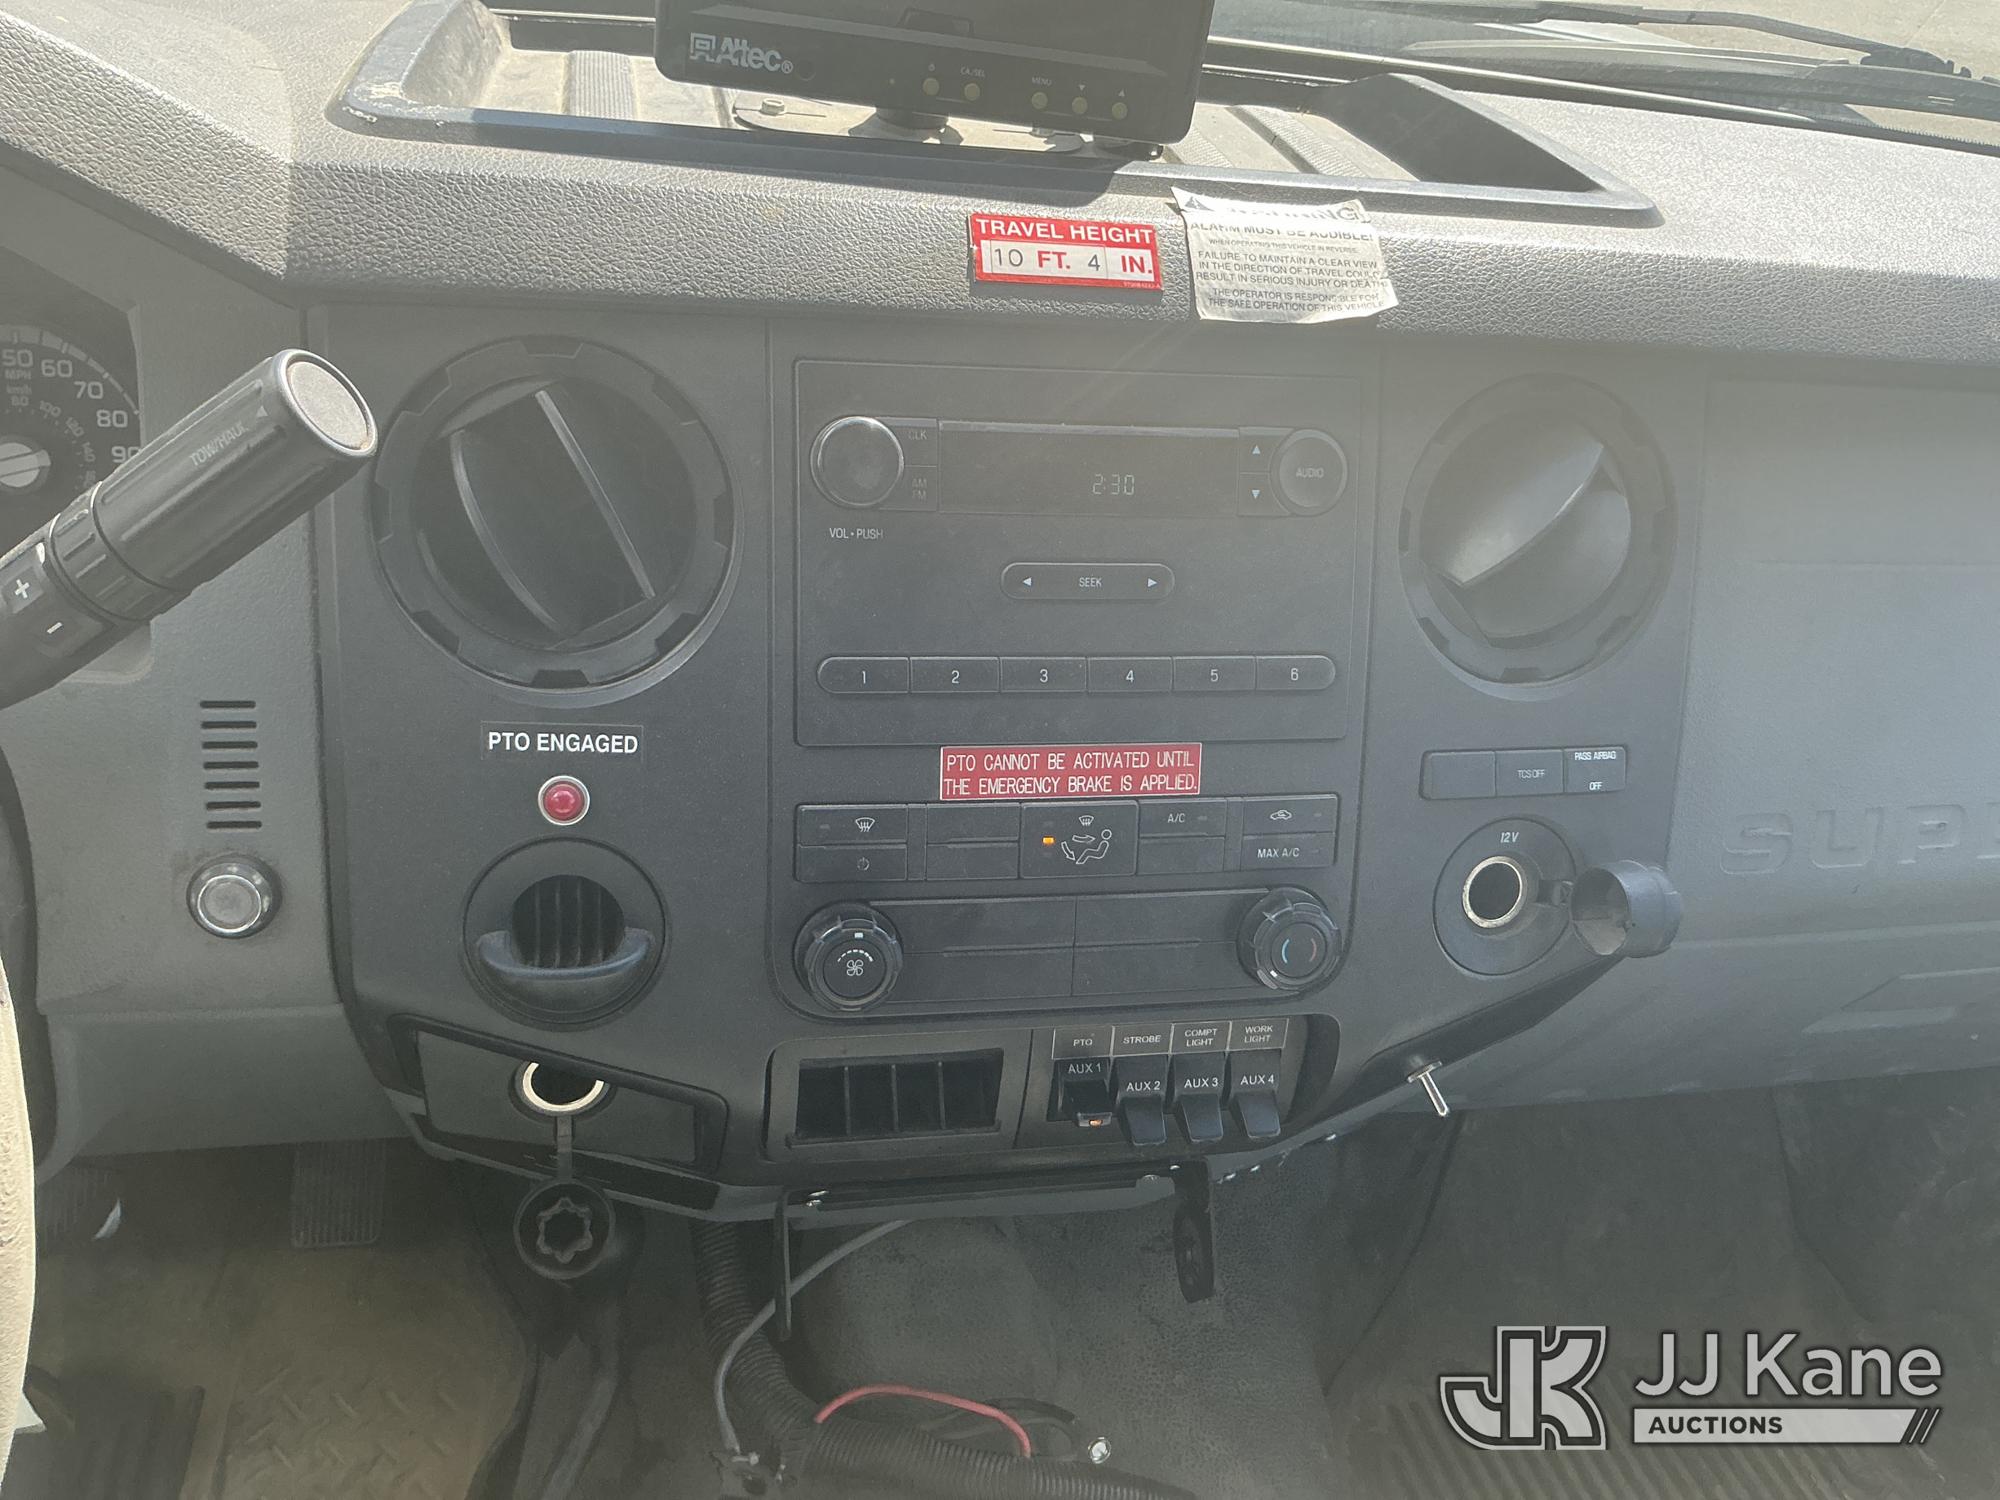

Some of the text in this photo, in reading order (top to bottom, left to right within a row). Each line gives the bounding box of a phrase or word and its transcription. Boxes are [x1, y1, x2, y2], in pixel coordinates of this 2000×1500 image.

[975, 218, 1153, 244] TRAVEL HEIGHT
[994, 248, 1153, 274] 10 FT. 4 IN.
[1198, 251, 1377, 269] FAILURE TO MAINTAIN A CLEAR VIEW
[1199, 261, 1209, 270] IN
[1211, 262, 1231, 271] THE
[1234, 263, 1287, 274] DIRECTION
[1289, 266, 1303, 275] OF
[1304, 267, 1343, 278] TRAVEL
[1196, 272, 1235, 282] RESULT
[1237, 273, 1247, 282] IN
[1250, 274, 1294, 285] SERIOUS
[1297, 277, 1331, 288] INJURY
[1333, 279, 1348, 288] OR
[1212, 287, 1231, 296] THE
[1232, 289, 1282, 299] OPERATOR
[1284, 292, 1293, 300] IS
[1208, 298, 1226, 306] THE
[1228, 299, 1251, 309] SAFE
[1253, 300, 1305, 311] OPERATION
[1307, 303, 1320, 312] OF
[5, 370, 32, 380] MPH
[2, 349, 34, 367] 50
[41, 359, 73, 378] 60
[74, 381, 104, 400] 70
[96, 409, 128, 428] 80
[908, 429, 928, 441] CLK
[1296, 466, 1325, 479] AUDIO
[1092, 473, 1136, 496] 2:30
[829, 527, 884, 540] VOL PUSH
[1078, 576, 1103, 588] SEEK
[861, 667, 1299, 685] 1 2 3 4 5 6
[487, 731, 639, 754] PTO ENGAGED
[946, 750, 1195, 772] PTO CANNOT BE ACTIVATED UNTIL
[1574, 750, 1617, 761] PASS AIRBAG
[1517, 768, 1546, 779] TCS OFF
[943, 773, 1198, 795] THE EMERGENCY BRAKE IS APPLIED.
[1589, 781, 1603, 791] OFF
[1167, 812, 1186, 824] A/C
[1256, 846, 1301, 860] MAX A/C
[1184, 1028, 1219, 1038] COMPT
[1244, 1024, 1274, 1034] WORK
[1073, 1037, 1093, 1047] PTO
[1122, 1034, 1161, 1045] STROBE
[1186, 1037, 1214, 1047] LIGHT
[1244, 1034, 1272, 1044] LIGHT
[1067, 1063, 1102, 1074] AUX 1
[1126, 1080, 1161, 1092] AUX 2
[1184, 1077, 1219, 1089] AUX 3
[1240, 1074, 1275, 1086] AUX 4
